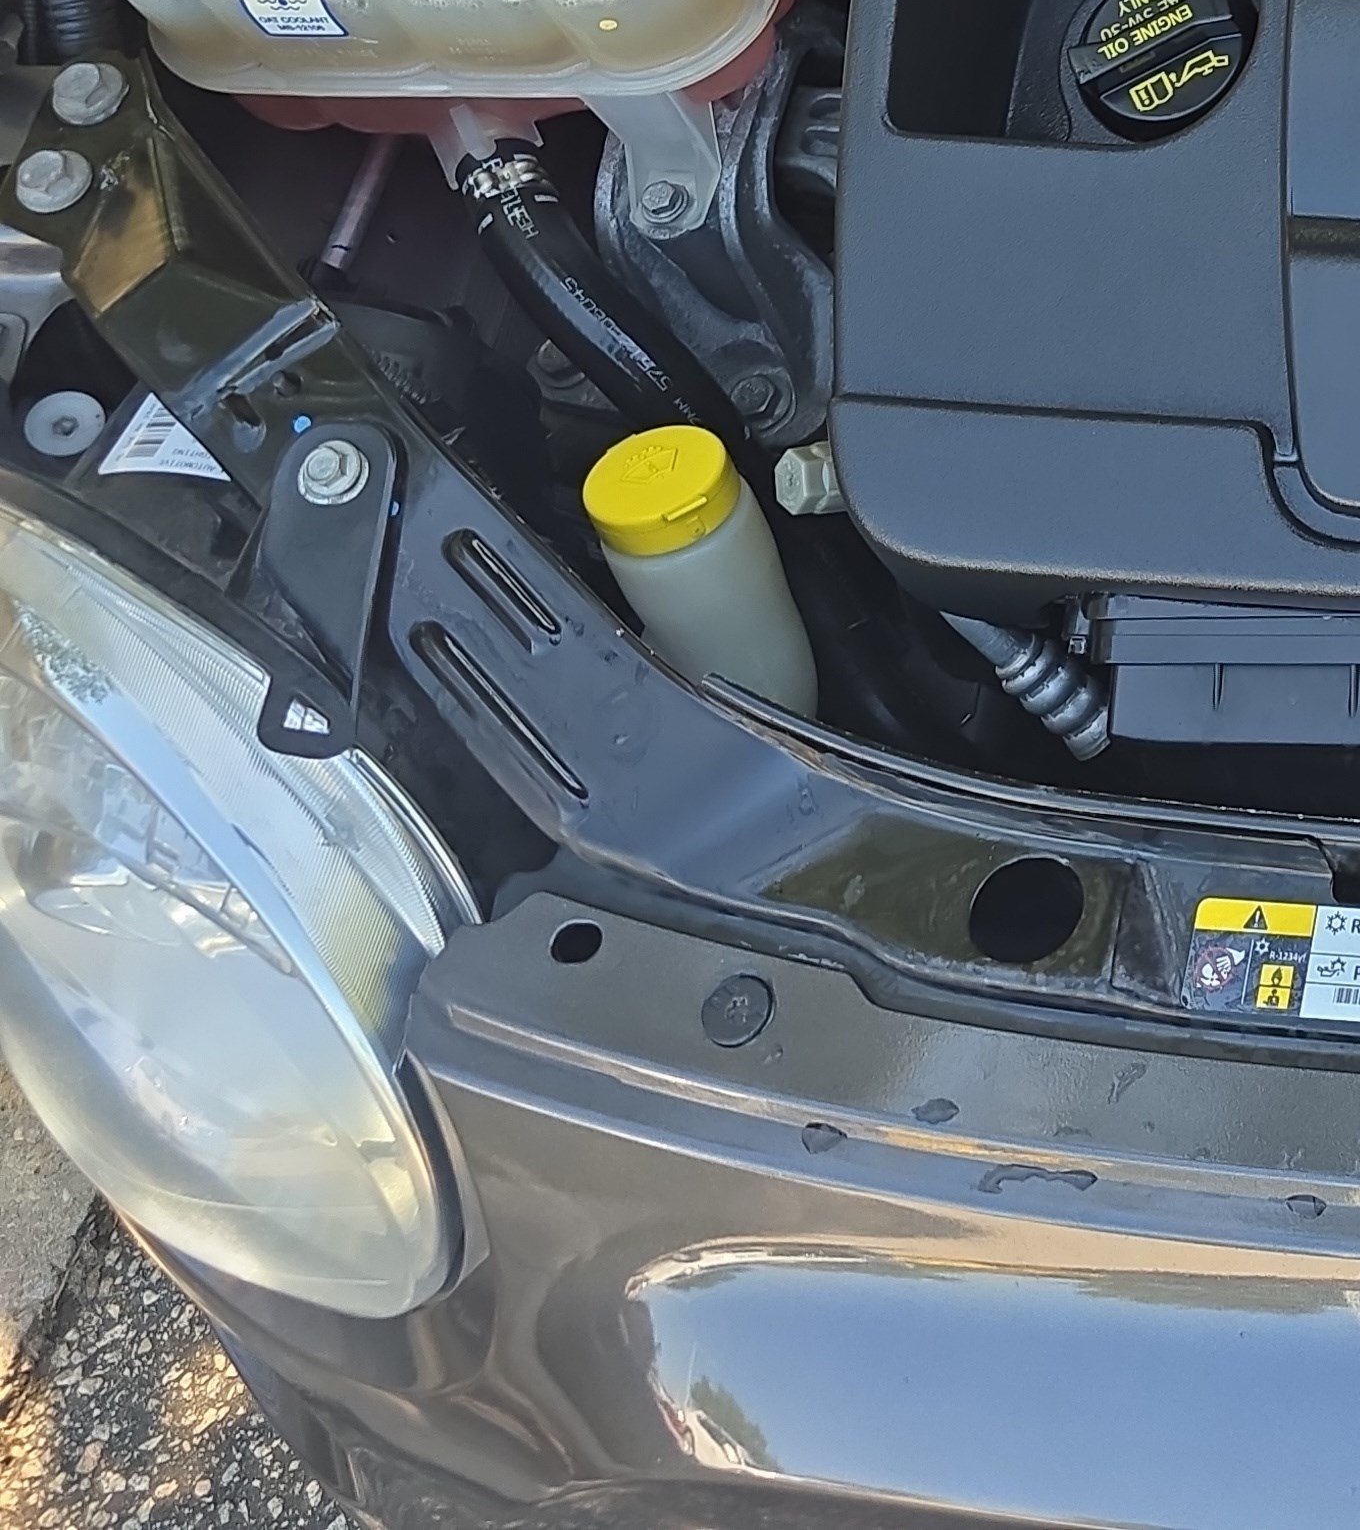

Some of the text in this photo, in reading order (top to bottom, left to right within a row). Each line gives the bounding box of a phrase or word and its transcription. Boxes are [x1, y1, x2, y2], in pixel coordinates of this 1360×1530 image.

[280, 16, 329, 24] COOLANT
[1096, 4, 1193, 60] ENGINE OIL
[1269, 951, 1307, 962] R-1234yf
